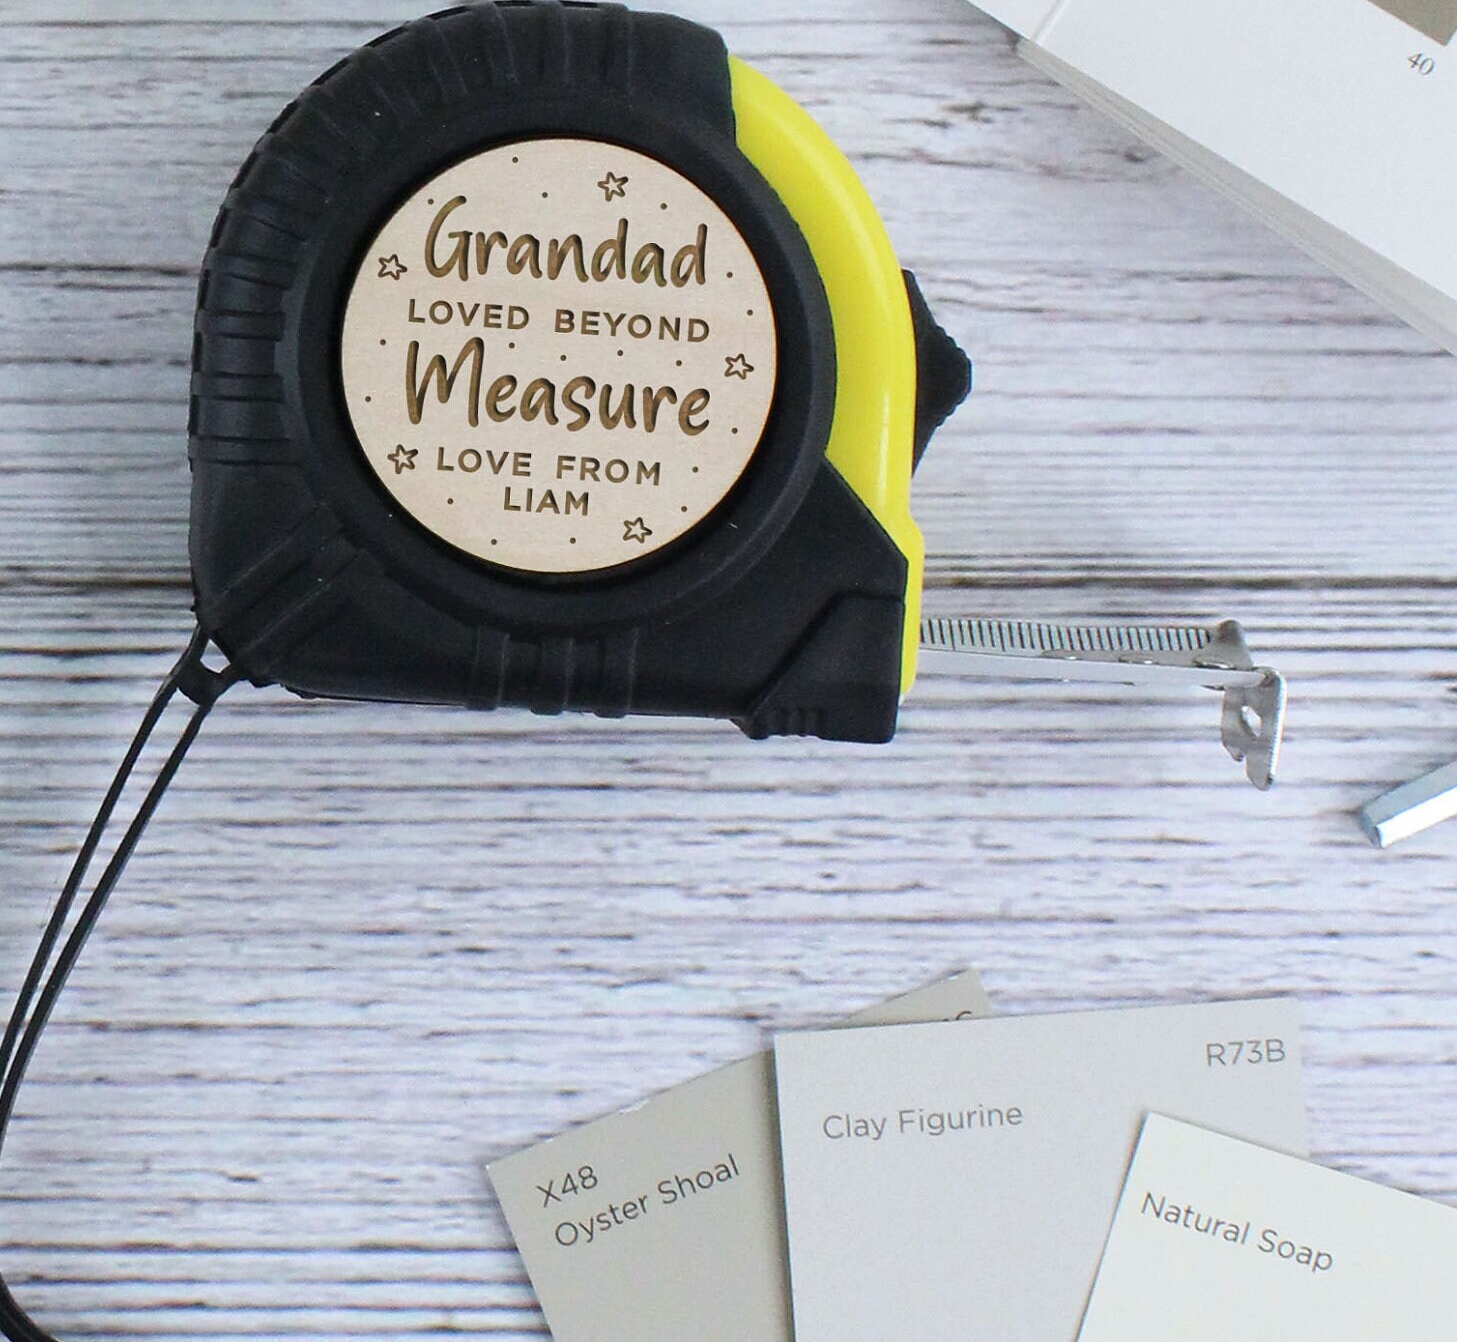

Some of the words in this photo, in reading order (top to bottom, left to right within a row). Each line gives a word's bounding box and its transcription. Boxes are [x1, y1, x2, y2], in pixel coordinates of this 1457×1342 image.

[1407, 52, 1436, 77] 40
[424, 195, 706, 289] Grandad
[407, 298, 530, 330] LOVED
[554, 308, 711, 343] BEYOND
[405, 336, 711, 436] Measure
[437, 447, 532, 478] LOVE
[556, 454, 661, 486] FROM
[503, 486, 590, 517] LIAM
[1205, 1038, 1287, 1067] R73B
[822, 1113, 887, 1142] Clay
[899, 1104, 1024, 1136] Figurine
[536, 1165, 598, 1208] X48
[555, 1195, 648, 1246] Oyster
[657, 1153, 740, 1204] Shoal
[1141, 1191, 1251, 1245] Natural
[1257, 1229, 1333, 1272] Soap
